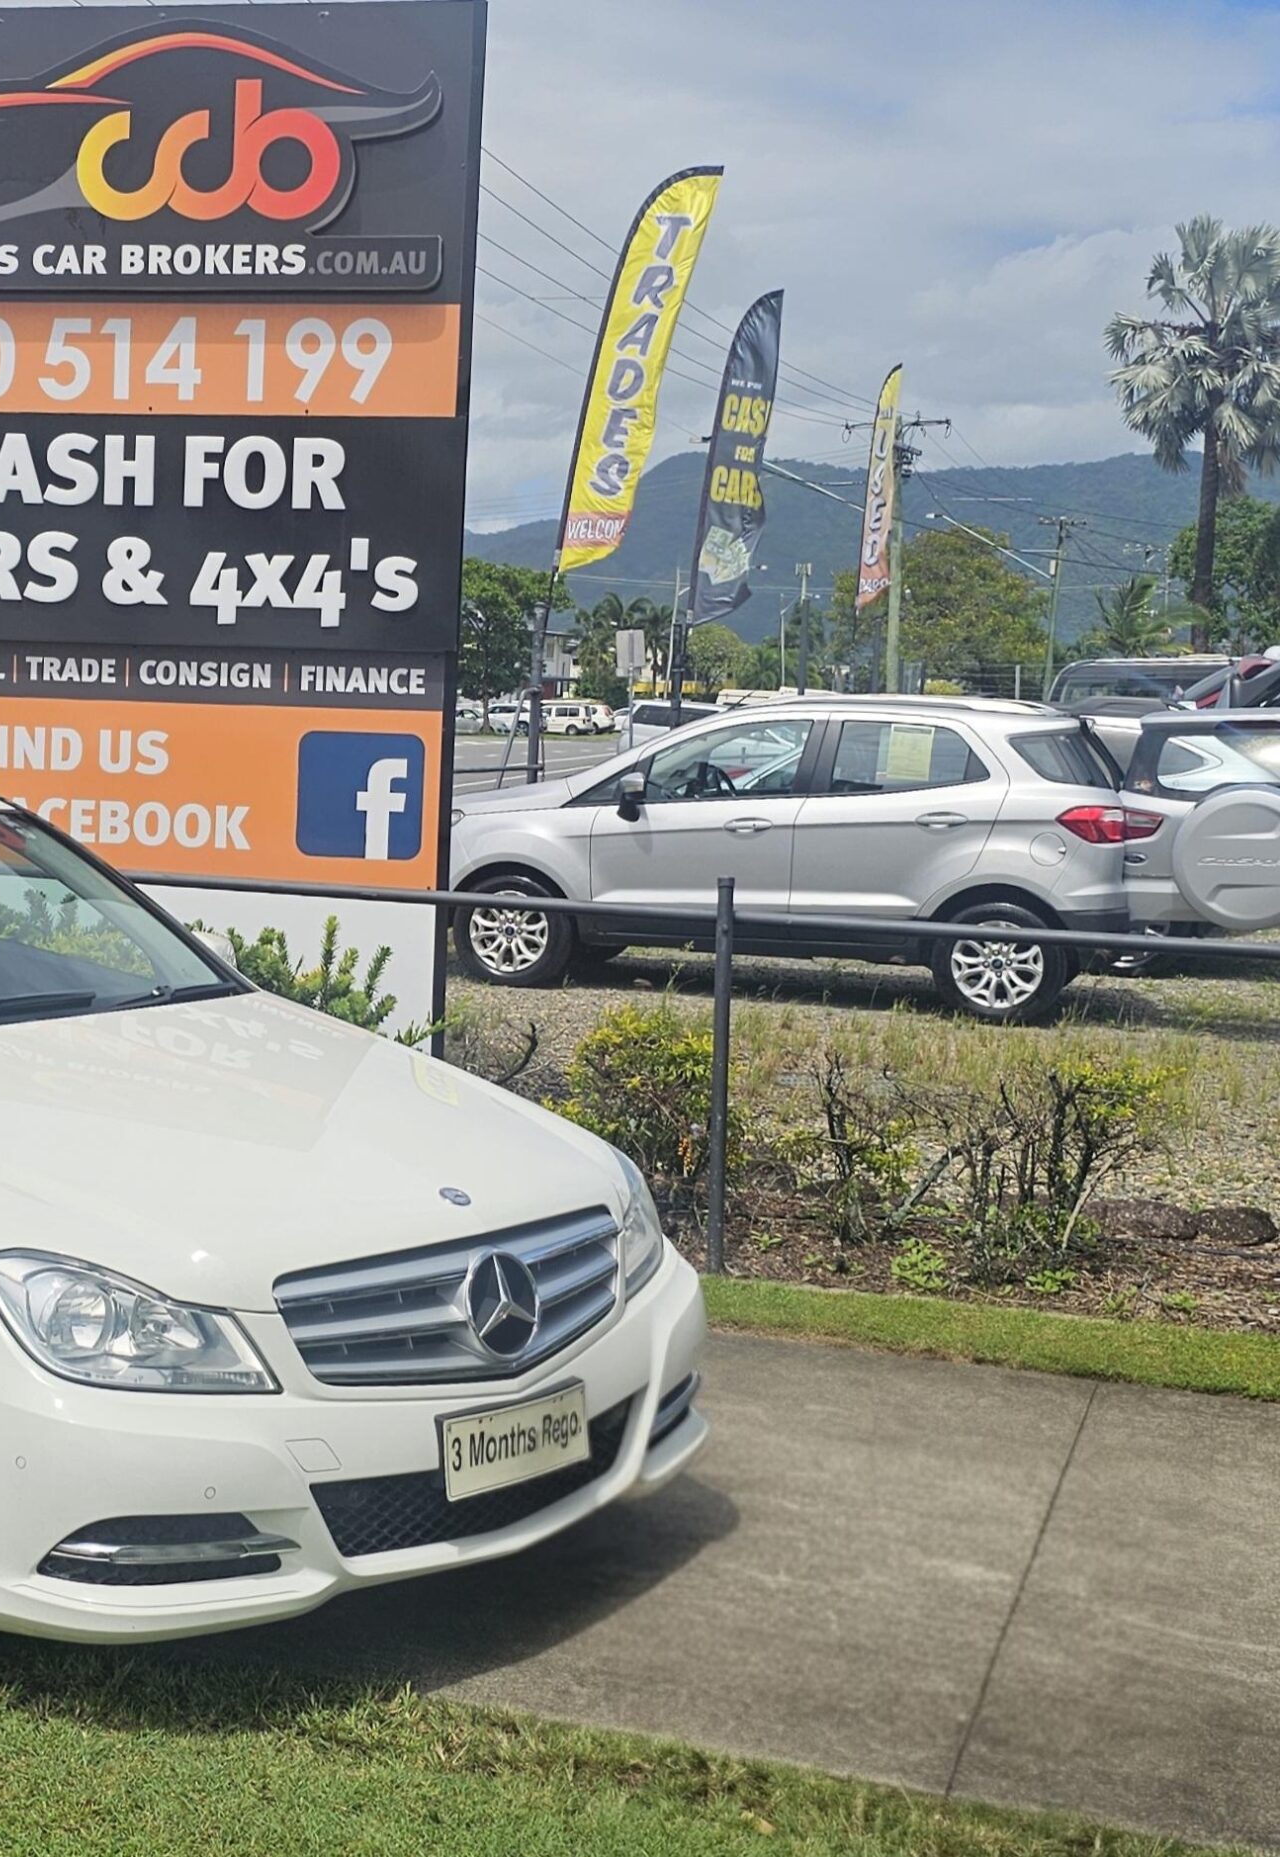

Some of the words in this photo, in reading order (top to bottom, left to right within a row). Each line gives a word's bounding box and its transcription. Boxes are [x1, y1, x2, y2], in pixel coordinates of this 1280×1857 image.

[32, 243, 108, 275] CAR
[38, 316, 202, 402] 514
[233, 318, 394, 405] 199
[589, 214, 693, 498] TRADES
[183, 435, 347, 511] FOR
[734, 445, 755, 463] FOR
[101, 536, 169, 606] &
[25, 656, 117, 685] TRADE
[139, 659, 272, 689] CONSIGN
[300, 665, 426, 695] FINANCE
[99, 729, 169, 775] US
[451, 1436, 462, 1472] 3
[469, 1422, 537, 1468] Months
[542, 1410, 582, 1449] Rego.
